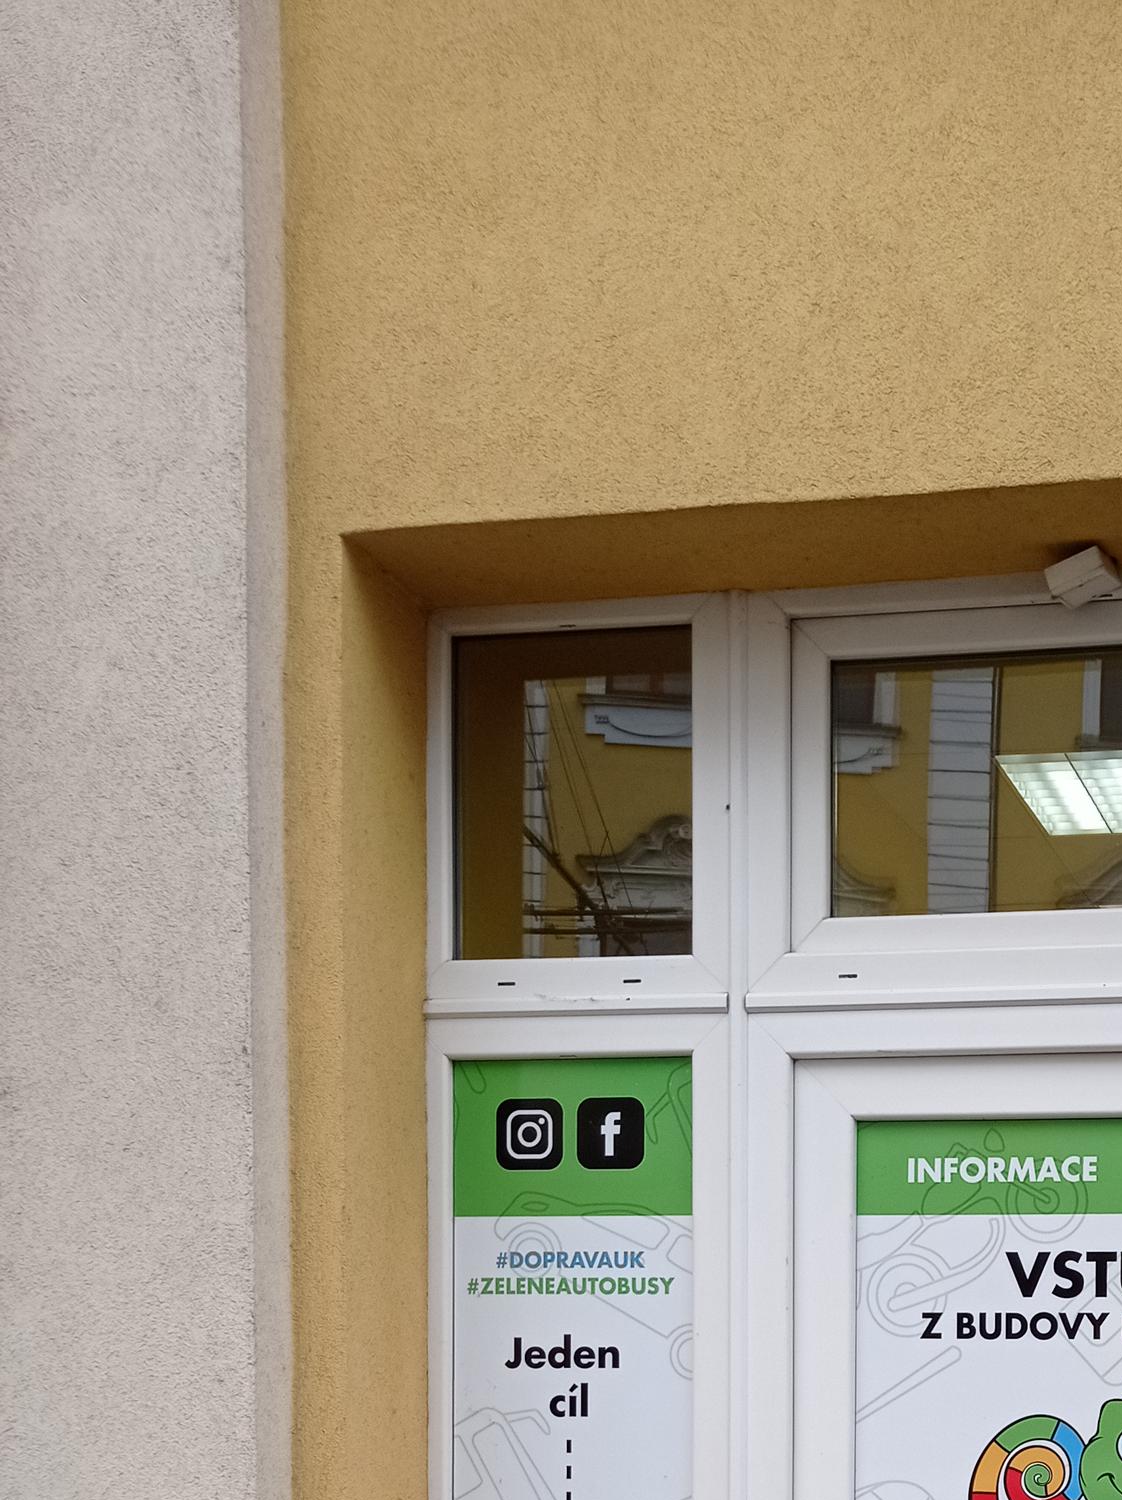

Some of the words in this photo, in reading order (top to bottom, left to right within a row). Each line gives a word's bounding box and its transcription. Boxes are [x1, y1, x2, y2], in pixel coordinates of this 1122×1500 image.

[601, 1112, 621, 1156] f
[907, 1156, 1098, 1183] INFORMACE
[496, 1251, 645, 1269] #DOPRAVAUK
[467, 1277, 675, 1296] #ZELENEAUTOBUSY
[920, 1312, 943, 1340] Z
[956, 1312, 1109, 1340] BUDOVY
[505, 1334, 620, 1369] Jeden
[550, 1383, 589, 1417] cíl
